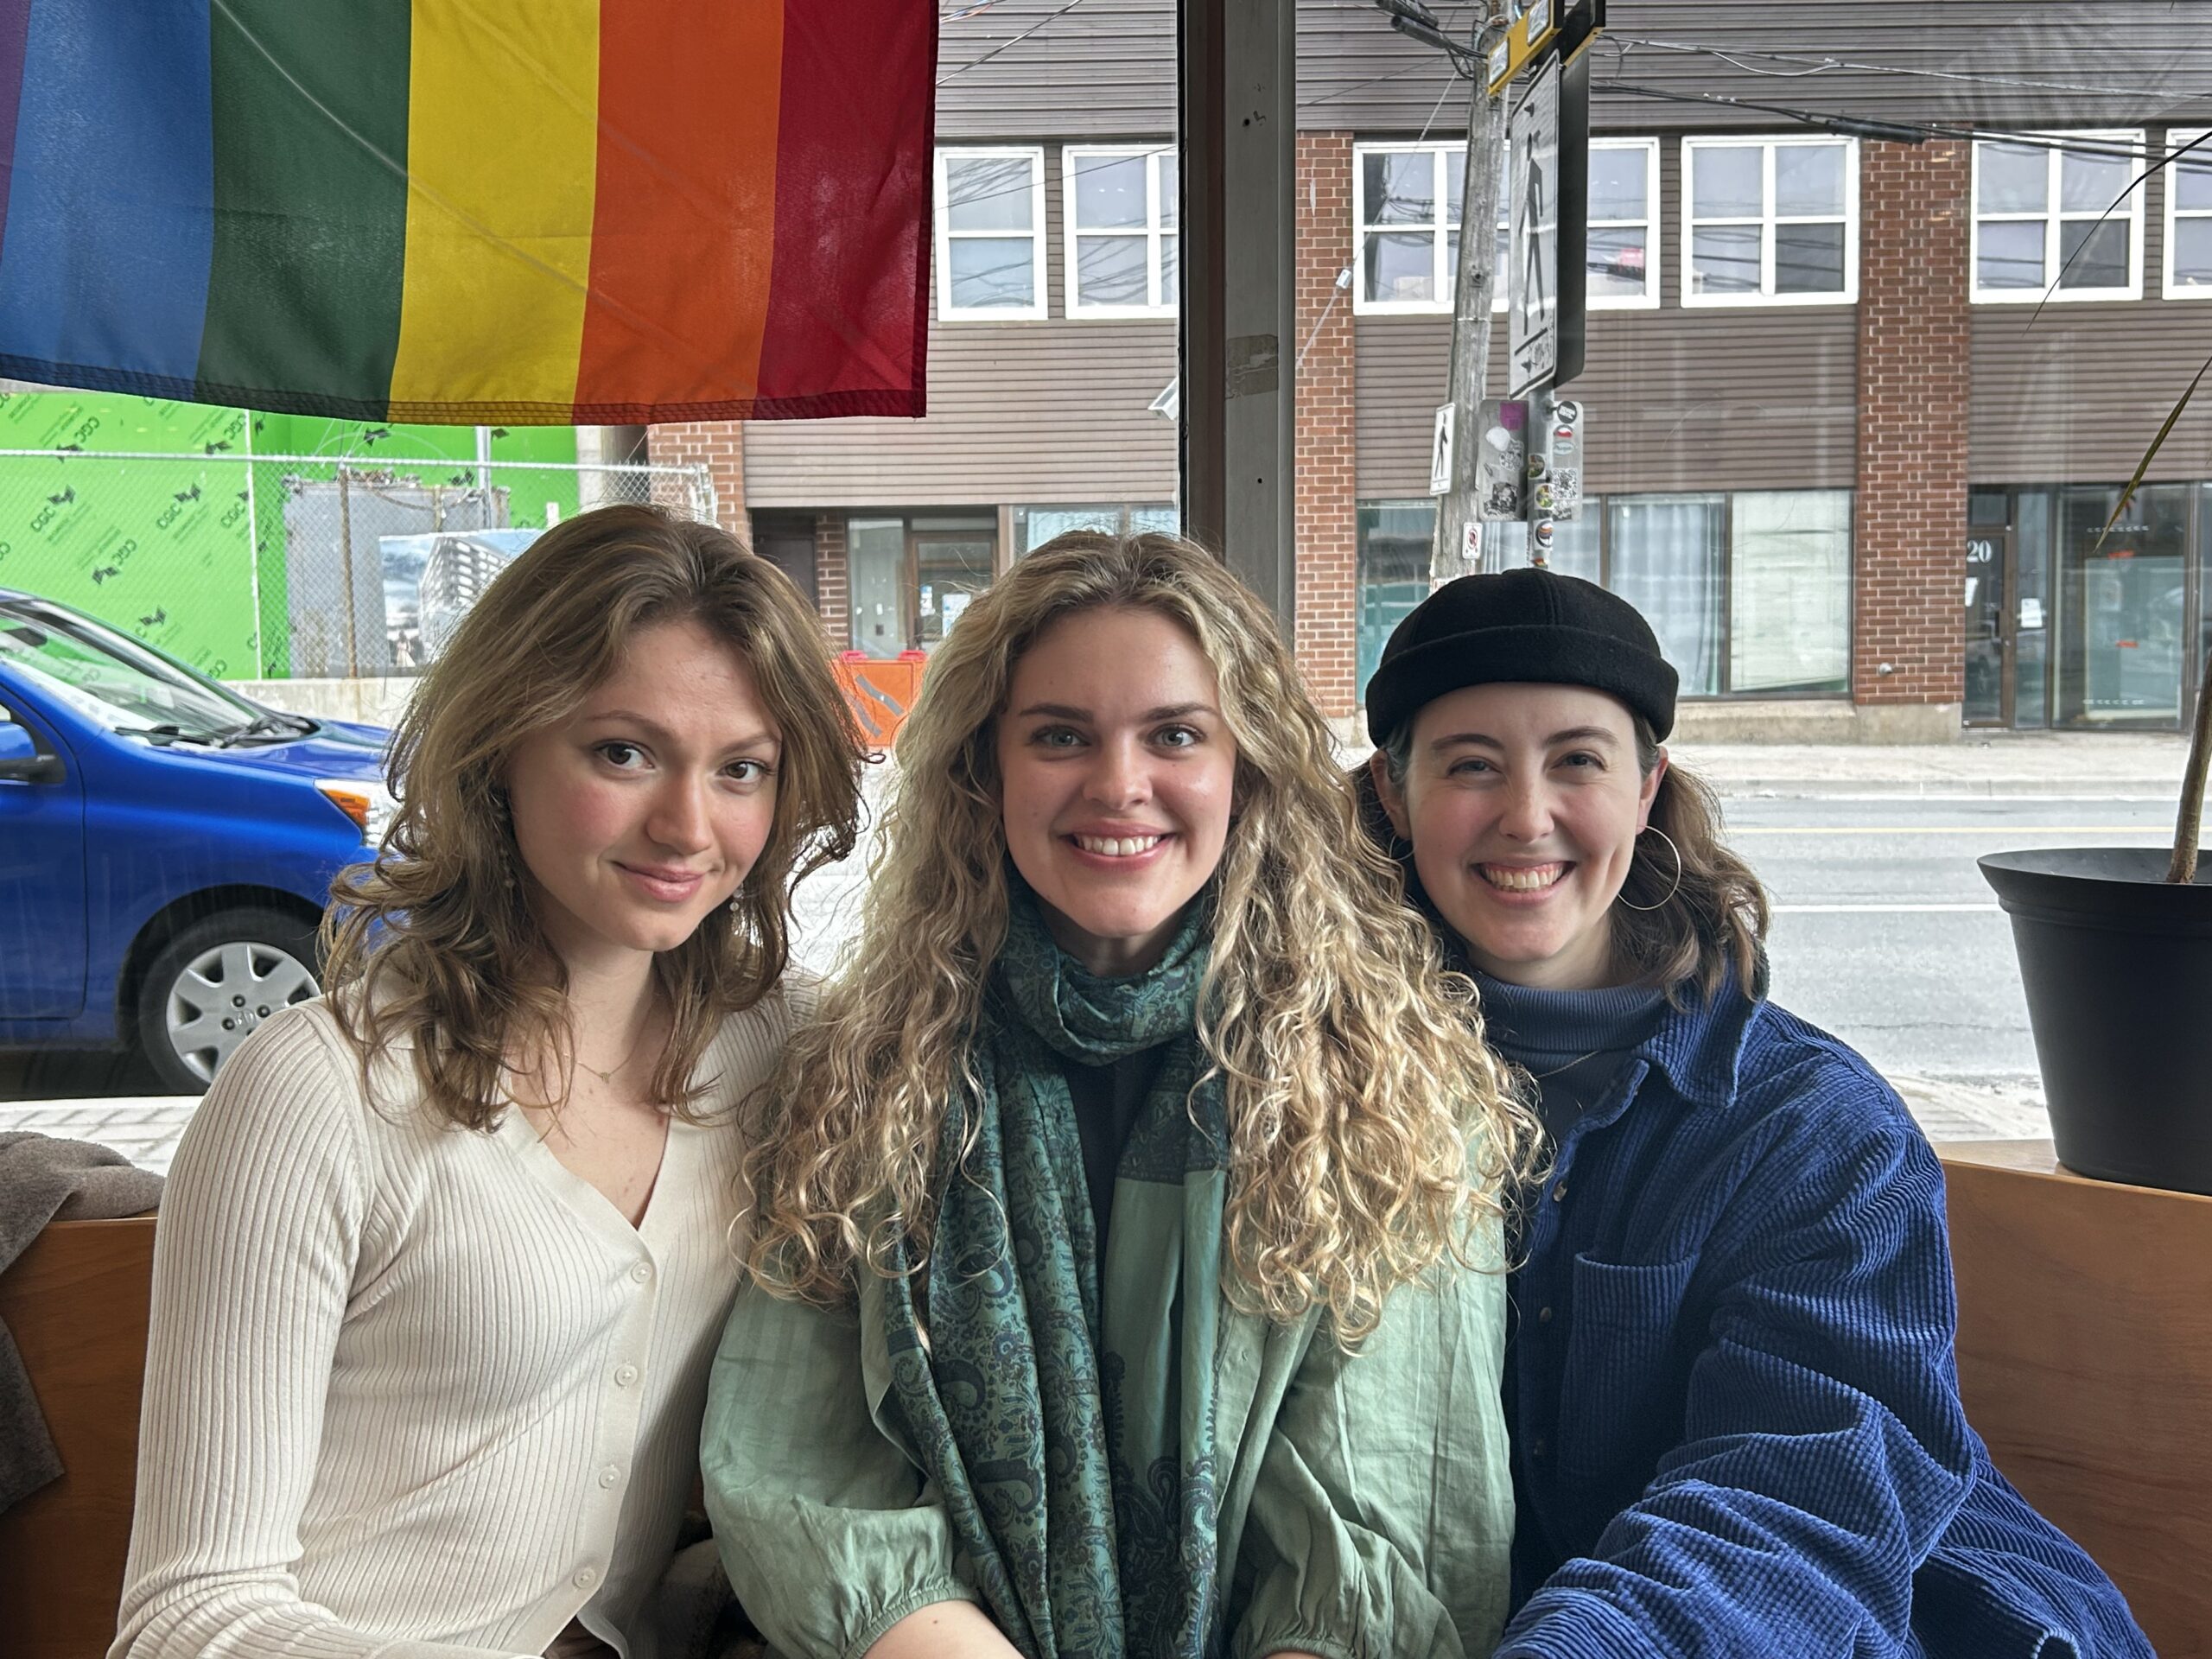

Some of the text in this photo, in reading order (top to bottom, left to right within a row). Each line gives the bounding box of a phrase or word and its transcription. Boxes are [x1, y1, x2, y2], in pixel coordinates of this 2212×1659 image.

[73, 416, 100, 443] CGC
[30, 505, 56, 532] CGC
[156, 502, 182, 530] CGC
[220, 501, 245, 529] CGC
[111, 538, 137, 566] CGC
[1966, 539, 1992, 563] 20
[207, 658, 227, 679] CG
